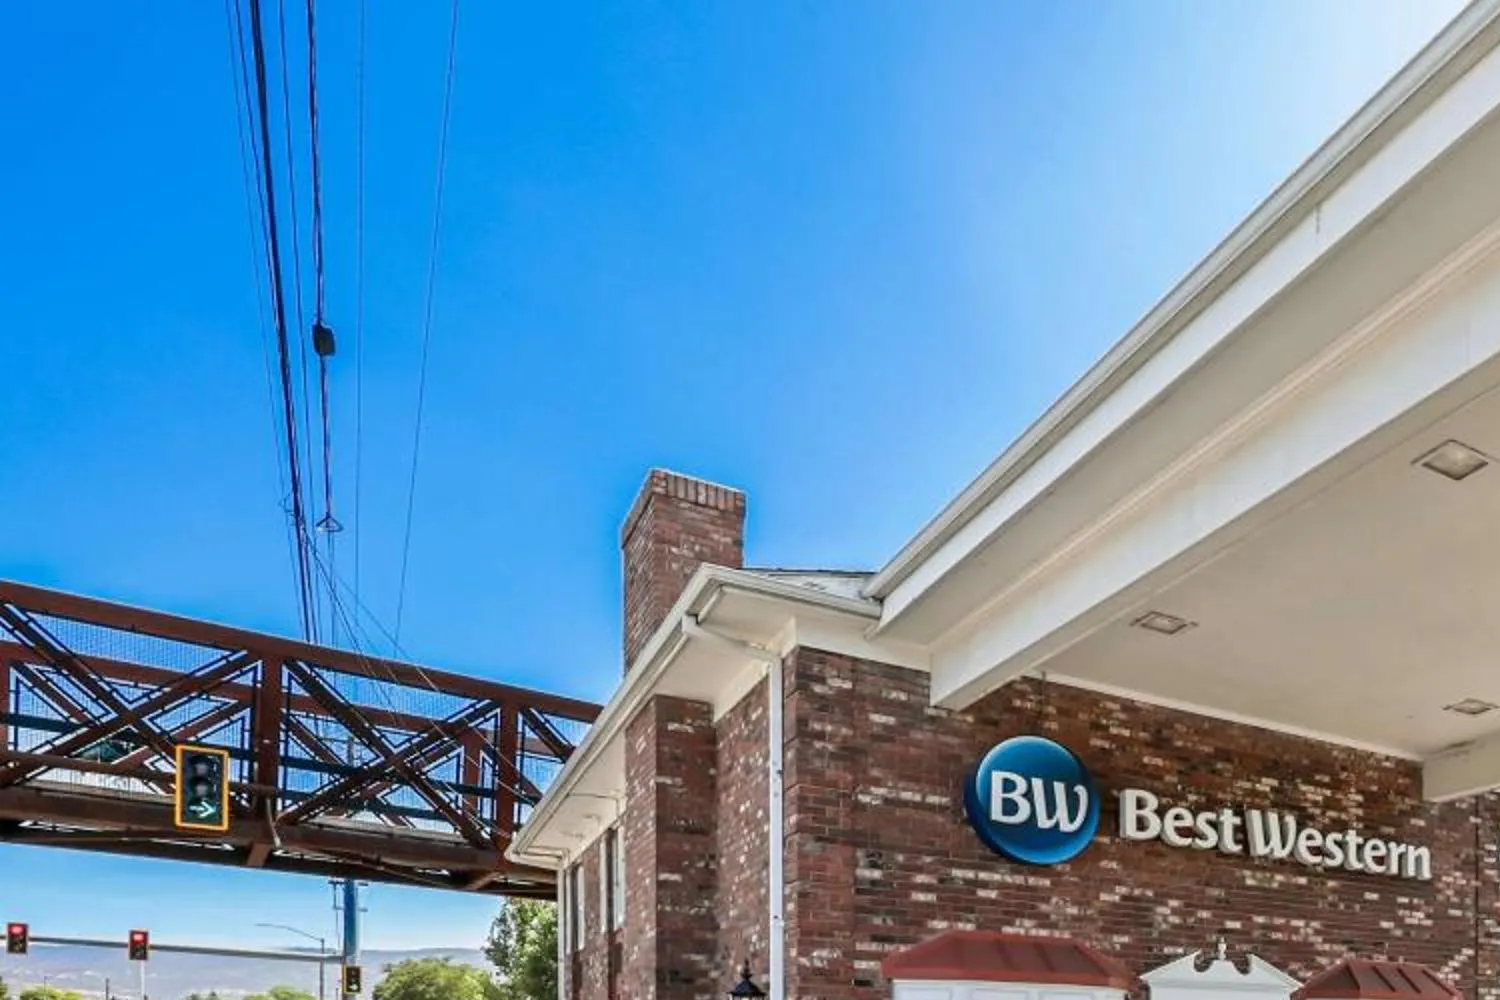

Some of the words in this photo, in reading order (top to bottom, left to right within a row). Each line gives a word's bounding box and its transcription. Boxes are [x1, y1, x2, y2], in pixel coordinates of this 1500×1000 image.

[990, 770, 1089, 833] BW
[1120, 788, 1244, 854] Best
[1246, 808, 1432, 880] Western
